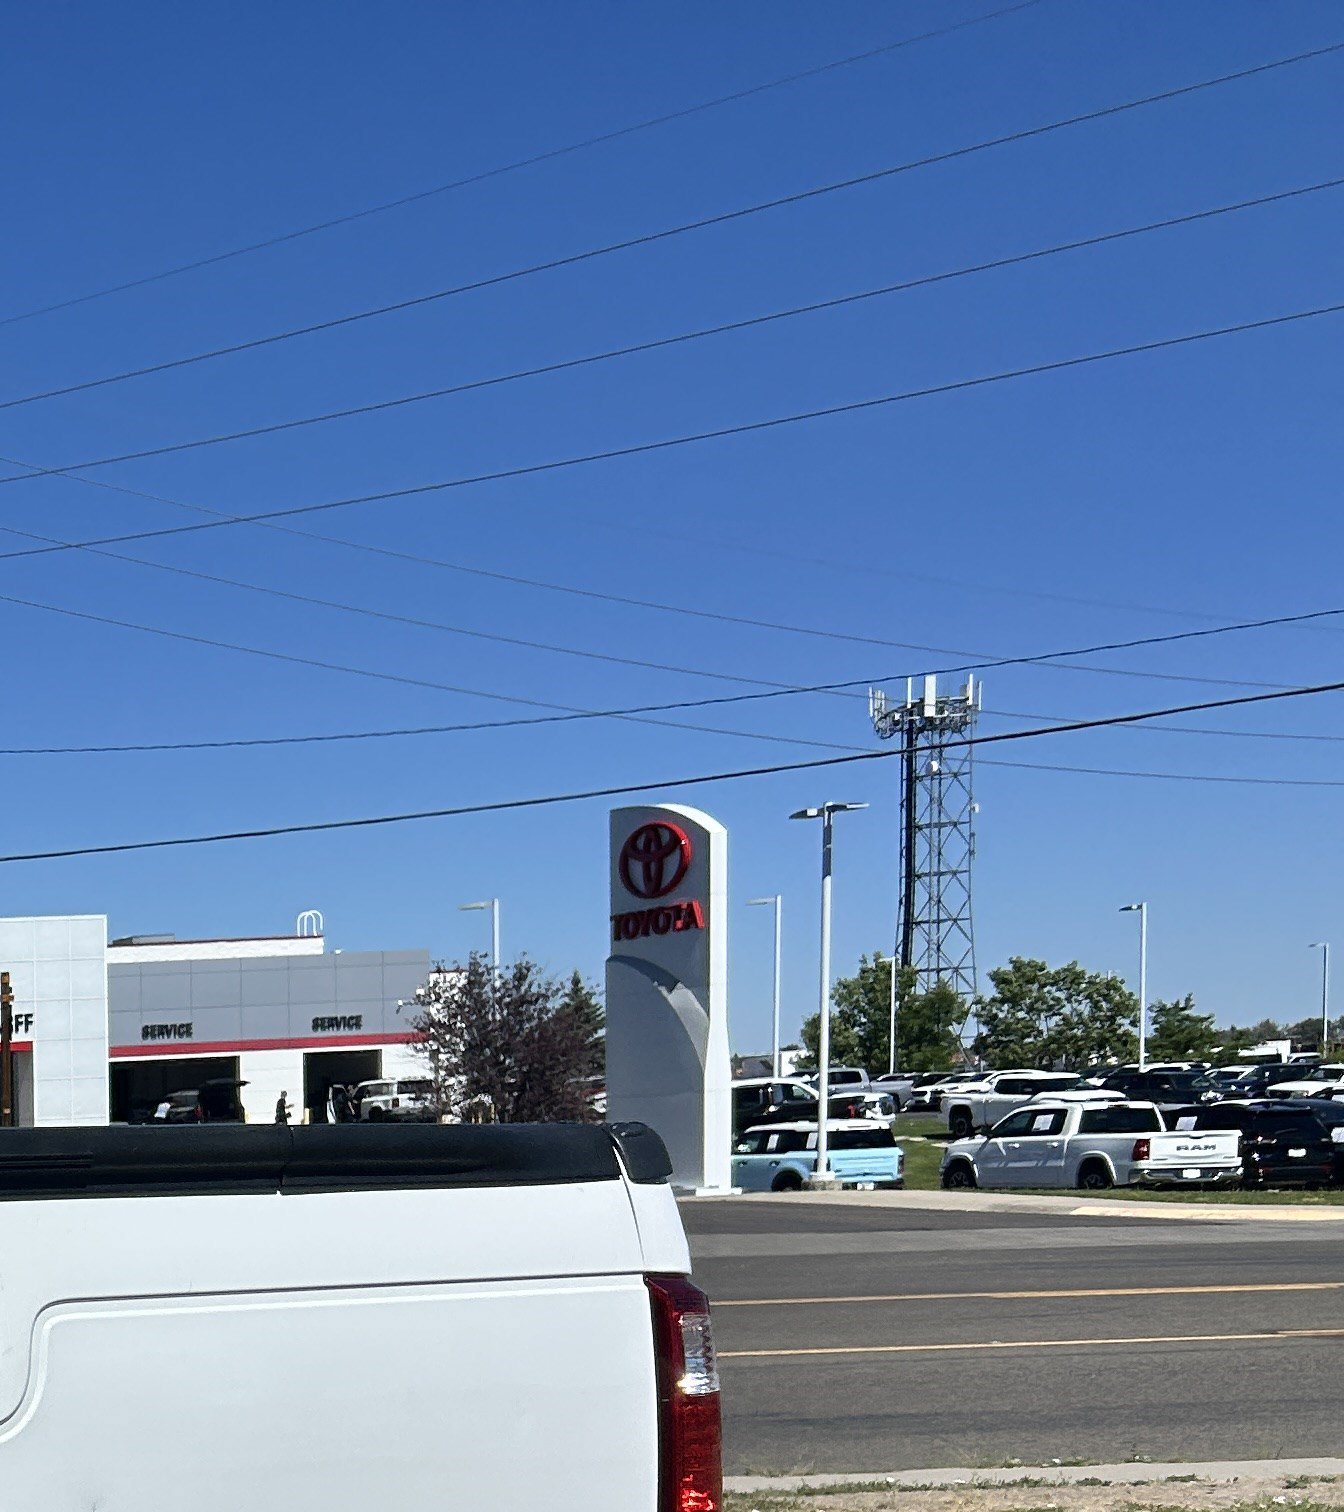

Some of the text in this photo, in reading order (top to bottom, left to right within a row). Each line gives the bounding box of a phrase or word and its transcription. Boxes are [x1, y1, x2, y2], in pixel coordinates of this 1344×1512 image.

[611, 899, 705, 940] TOYOTA
[141, 1022, 193, 1040] SERVICE
[312, 1014, 362, 1032] SERVICE
